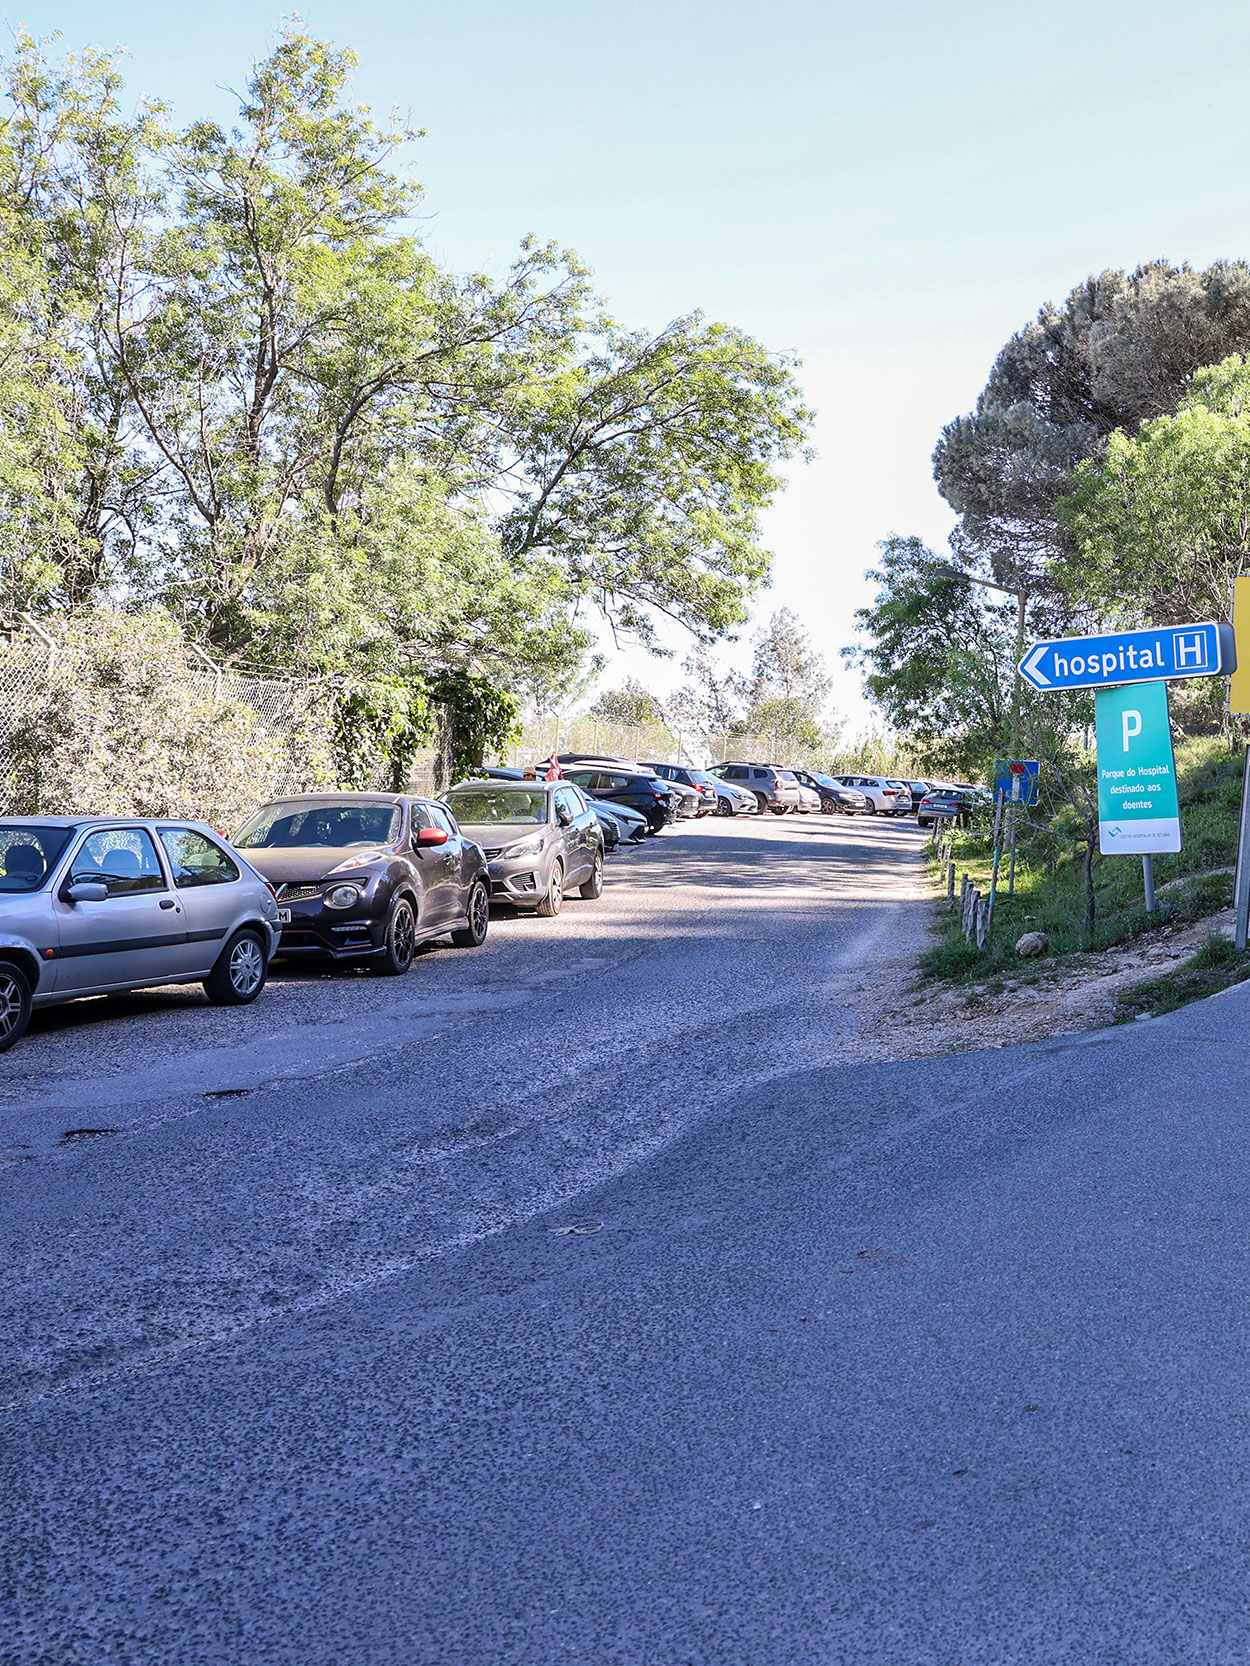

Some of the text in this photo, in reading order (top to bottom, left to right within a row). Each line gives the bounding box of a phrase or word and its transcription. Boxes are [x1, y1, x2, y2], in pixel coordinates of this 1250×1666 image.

[1053, 641, 1165, 677] hospital
[1121, 709, 1142, 752] P
[1101, 764, 1170, 780] Parque do Hospital
[1110, 783, 1161, 795] destinado aos
[1122, 800, 1152, 810] doentes
